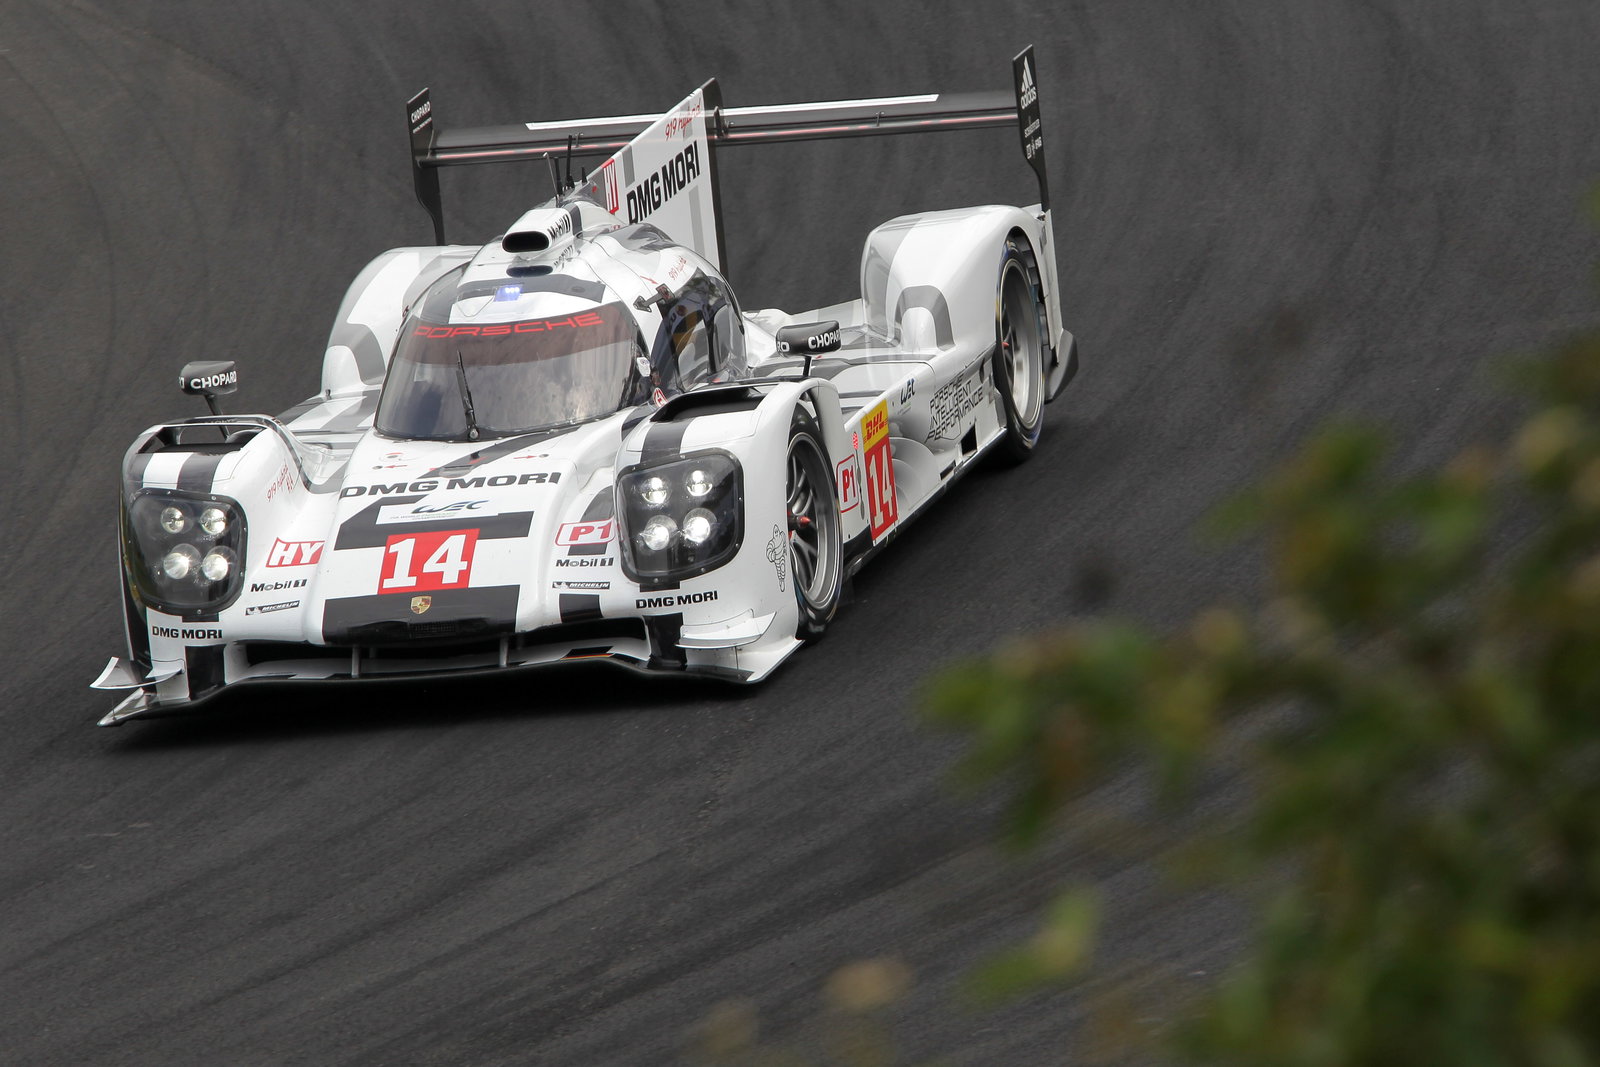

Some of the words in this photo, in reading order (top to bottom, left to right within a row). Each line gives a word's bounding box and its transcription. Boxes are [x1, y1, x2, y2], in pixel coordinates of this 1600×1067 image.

[627, 172, 662, 225] DMG
[661, 140, 700, 202] MORI
[412, 312, 604, 339] PORSCHE
[190, 371, 237, 389] CHOPARD
[901, 378, 915, 405] WEC
[866, 411, 885, 440] DHL
[338, 480, 439, 500] DMG
[446, 472, 562, 490] MORI
[842, 466, 857, 502] P1
[869, 444, 894, 529] 14
[411, 500, 490, 514] WEC
[568, 522, 613, 541] P1
[268, 540, 324, 567] HY
[382, 534, 468, 589] 14
[556, 559, 598, 567] Mobil
[250, 581, 292, 592] Mobil
[635, 596, 675, 609] DMG
[677, 591, 718, 606] MORI
[262, 601, 299, 612] MICHELIN
[152, 625, 179, 638] DMG
[181, 629, 223, 639] MORI
